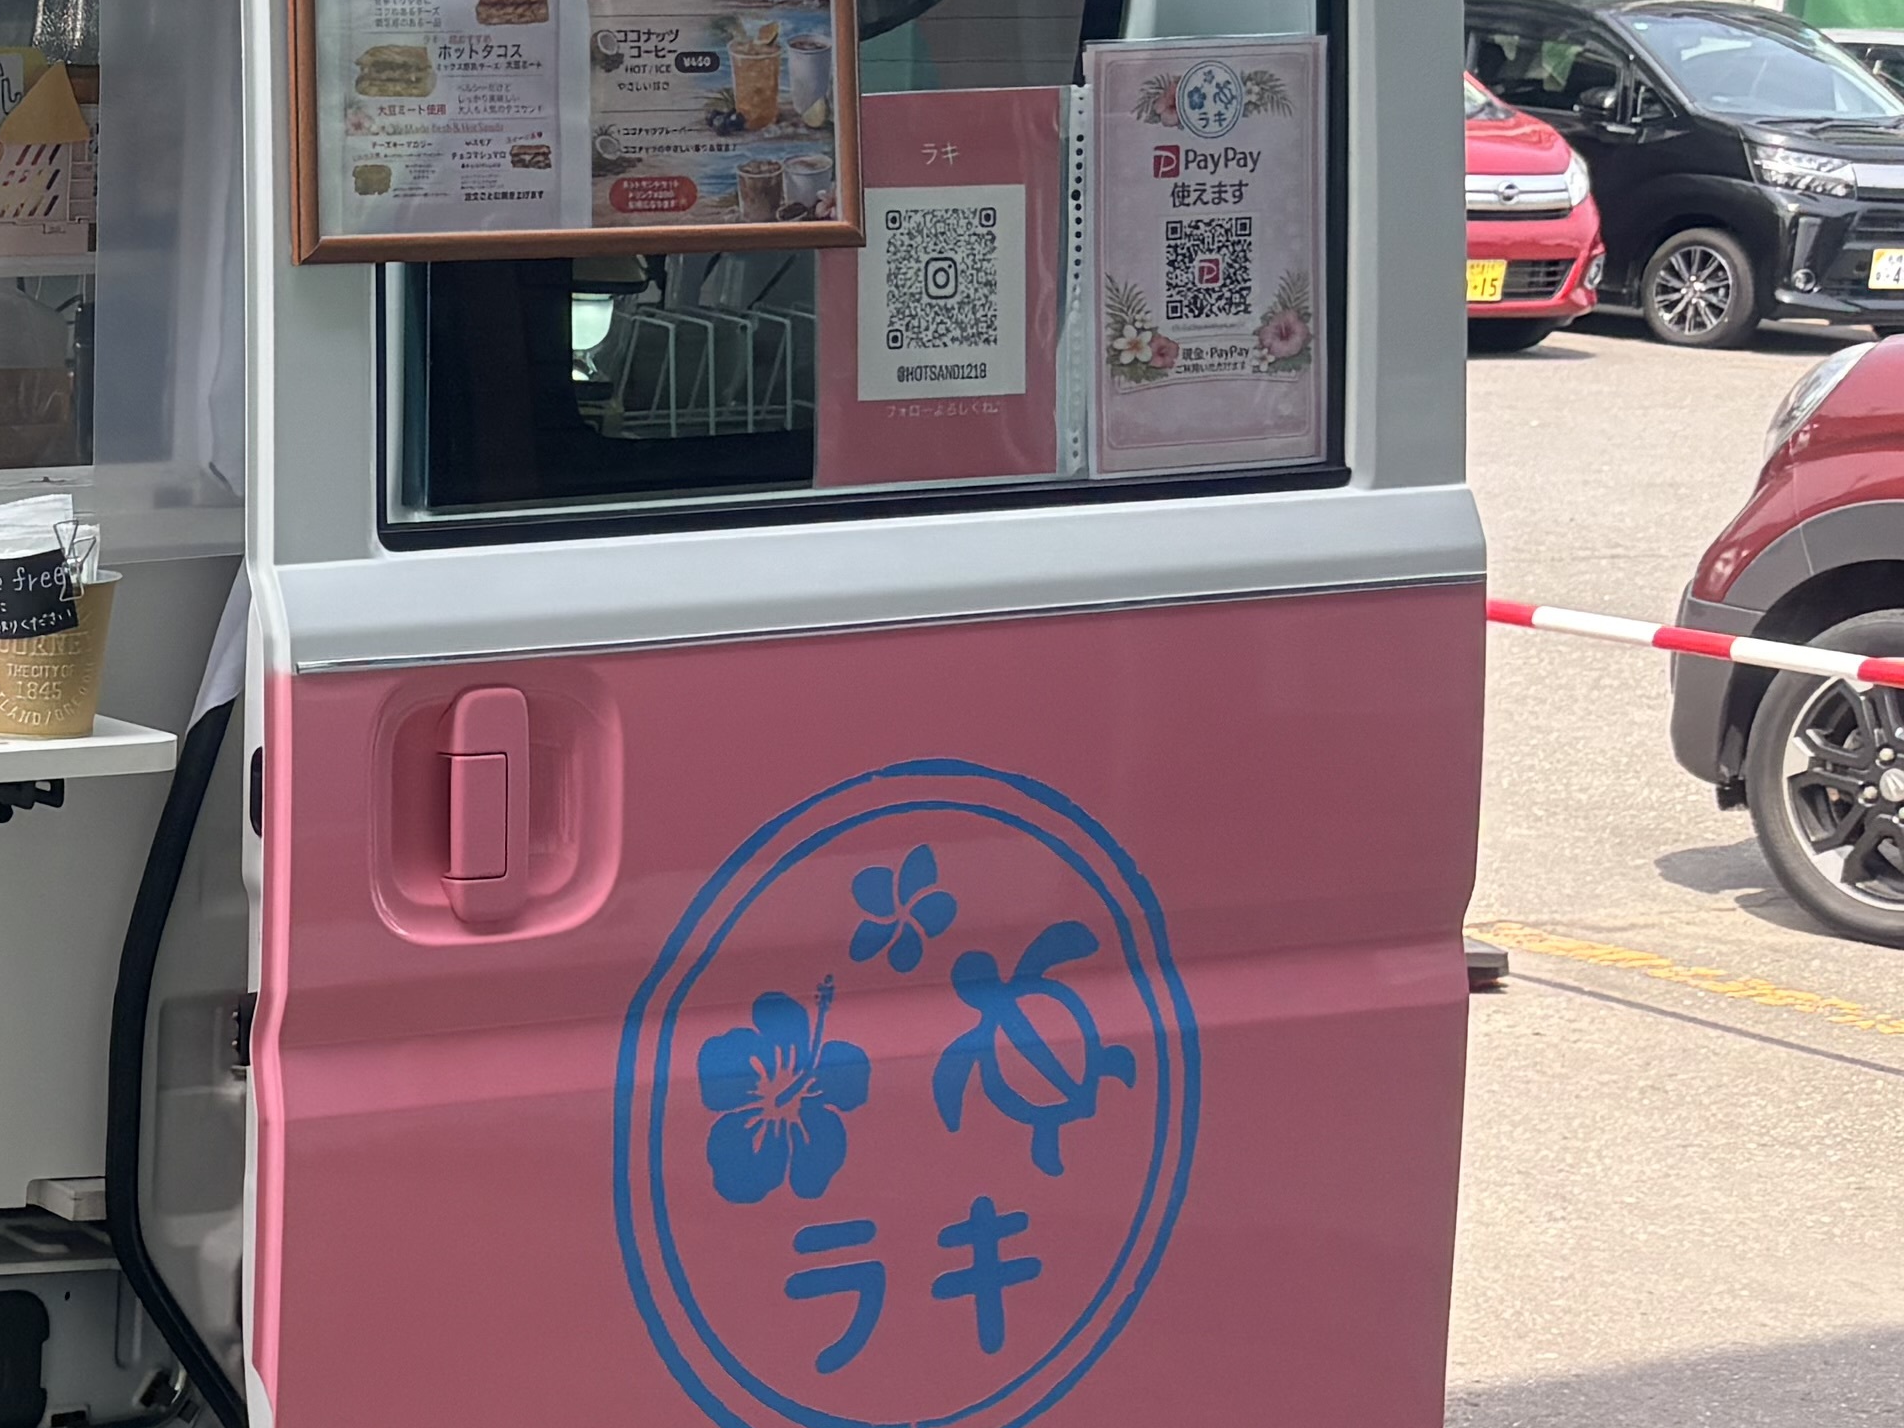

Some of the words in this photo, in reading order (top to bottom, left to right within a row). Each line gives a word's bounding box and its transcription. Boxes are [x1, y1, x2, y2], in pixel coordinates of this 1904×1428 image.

[616, 28, 680, 44] ココナッツ
[437, 43, 523, 61] ホットタコス
[629, 45, 678, 59] コーヒー
[378, 103, 447, 117] 大豆ミート使用
[1198, 110, 1227, 129] ラキ
[921, 142, 960, 165] ラキ
[1184, 146, 1262, 175] PayPay
[1170, 179, 1249, 208] 使えます
[896, 362, 988, 384] @HOTSAND1218
[12, 566, 66, 592] free
[15, 680, 63, 701] 1845
[783, 1195, 1043, 1375] ラキ
